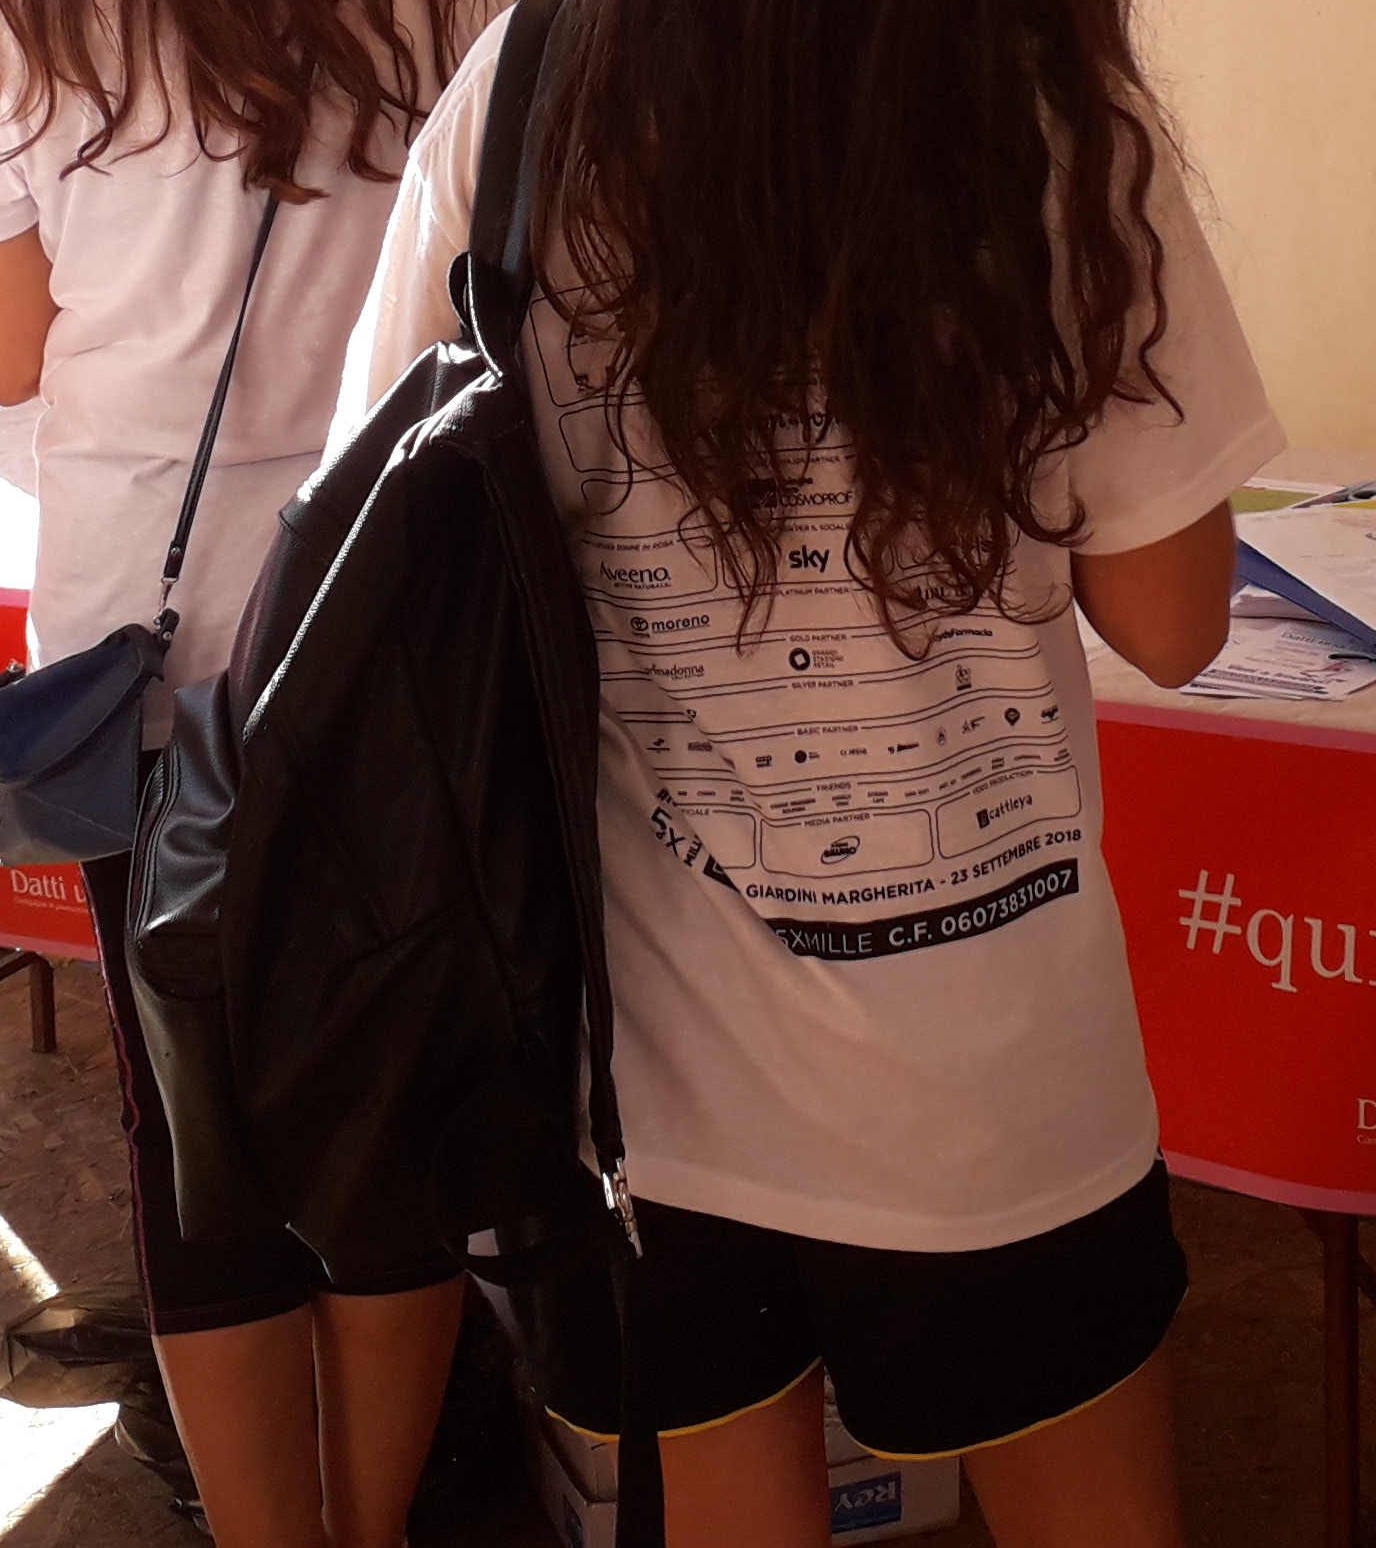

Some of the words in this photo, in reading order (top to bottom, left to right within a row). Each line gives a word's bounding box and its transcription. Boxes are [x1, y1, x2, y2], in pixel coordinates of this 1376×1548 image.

[788, 544, 830, 574] sky
[989, 793, 1034, 821] cattleya
[745, 883, 818, 904] GIARDINI
[821, 878, 936, 905] MARGHERITA
[950, 867, 968, 886] 23
[972, 835, 1042, 879] SETTEMBRE
[1044, 829, 1082, 847] 2018
[10, 868, 68, 901] Datti
[888, 921, 933, 947] C.F.
[940, 868, 1074, 938] 06073831007
